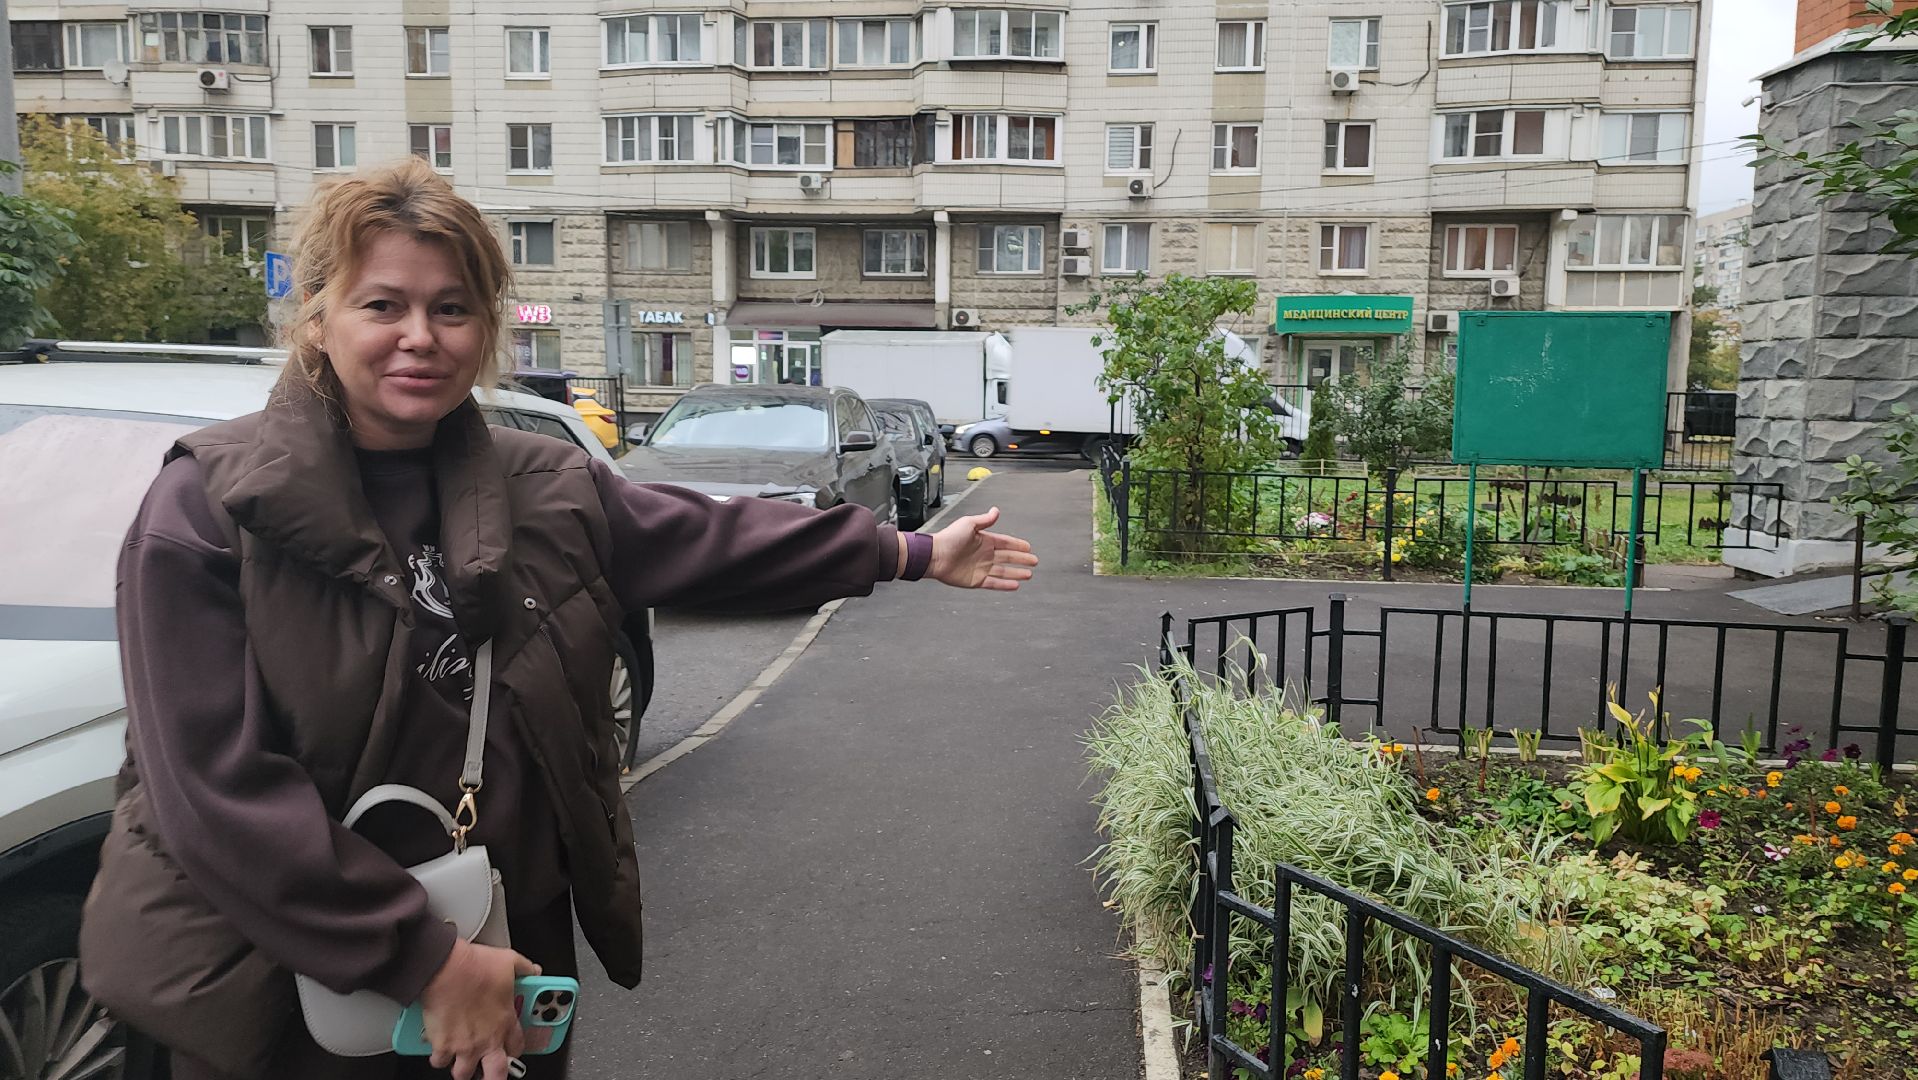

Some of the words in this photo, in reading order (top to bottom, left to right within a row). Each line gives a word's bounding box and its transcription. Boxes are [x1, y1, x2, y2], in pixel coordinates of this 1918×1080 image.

[516, 304, 552, 324] WB
[638, 310, 685, 324] ТАБАК
[1283, 306, 1372, 321] МЕДИЦИНСКИЙ
[1374, 309, 1408, 321] ЦЕНТР
